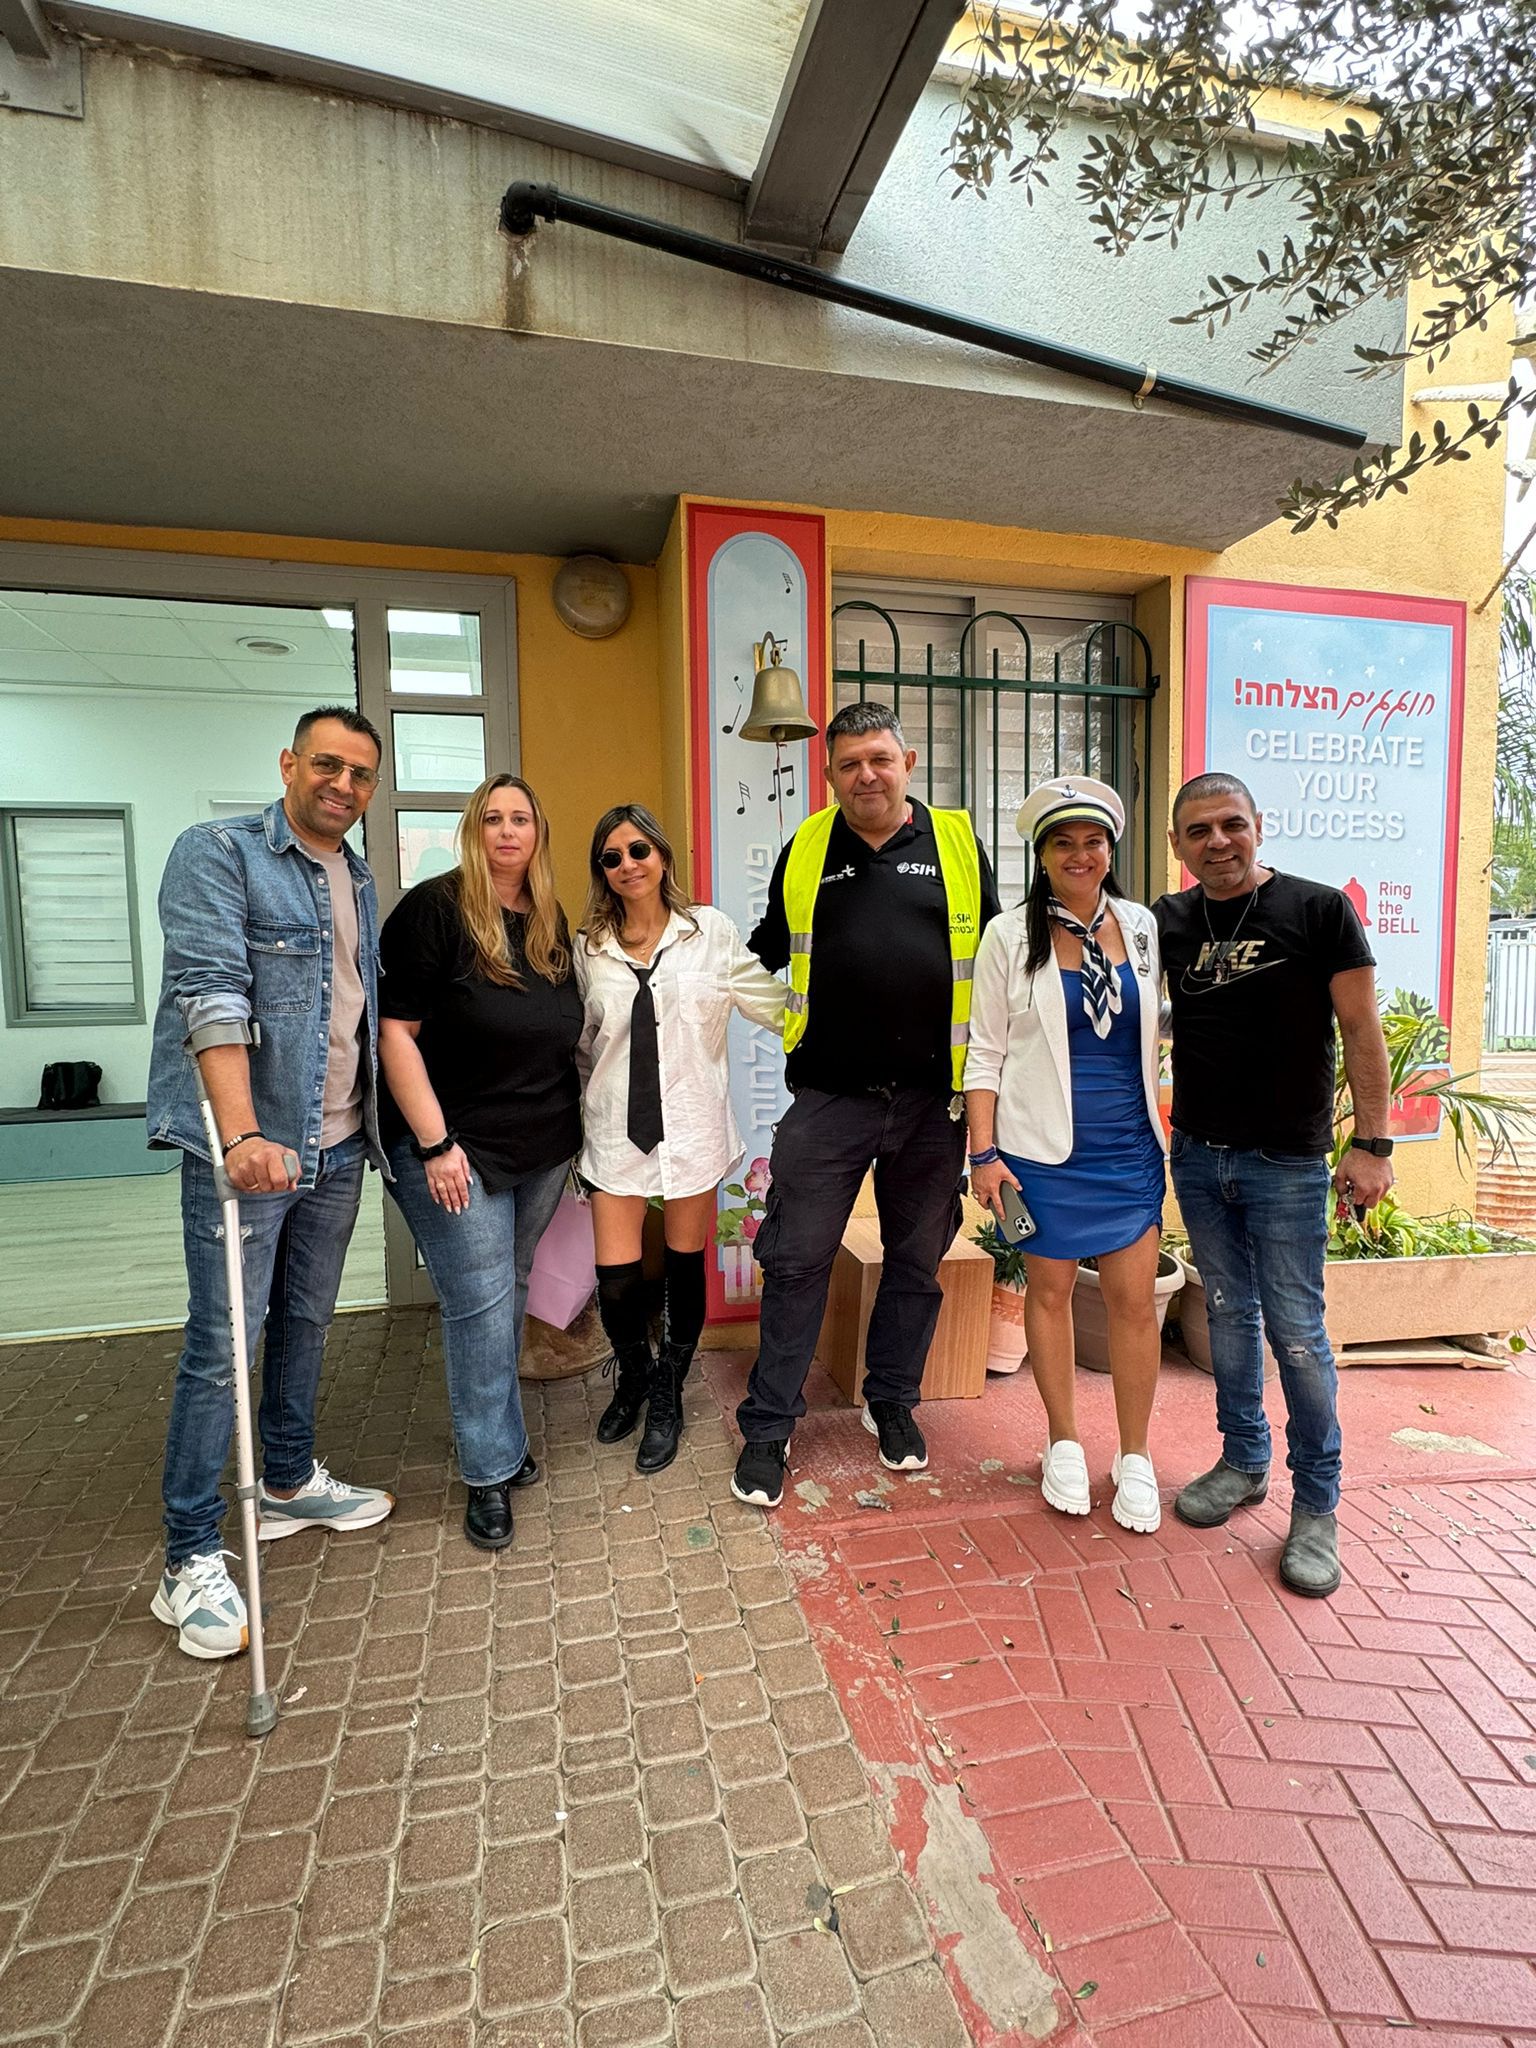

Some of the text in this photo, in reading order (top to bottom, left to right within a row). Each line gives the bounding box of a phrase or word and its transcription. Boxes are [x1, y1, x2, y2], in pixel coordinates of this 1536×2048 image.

[1235, 678, 1338, 710] הצלחה!
[1245, 728, 1424, 766] CELEBRATE
[1293, 770, 1377, 802] YOUR
[1262, 807, 1405, 840] SUCCESS
[909, 863, 936, 877] SIH
[1379, 881, 1412, 900] Ring
[1378, 900, 1403, 915] the
[1379, 917, 1420, 934] BELL
